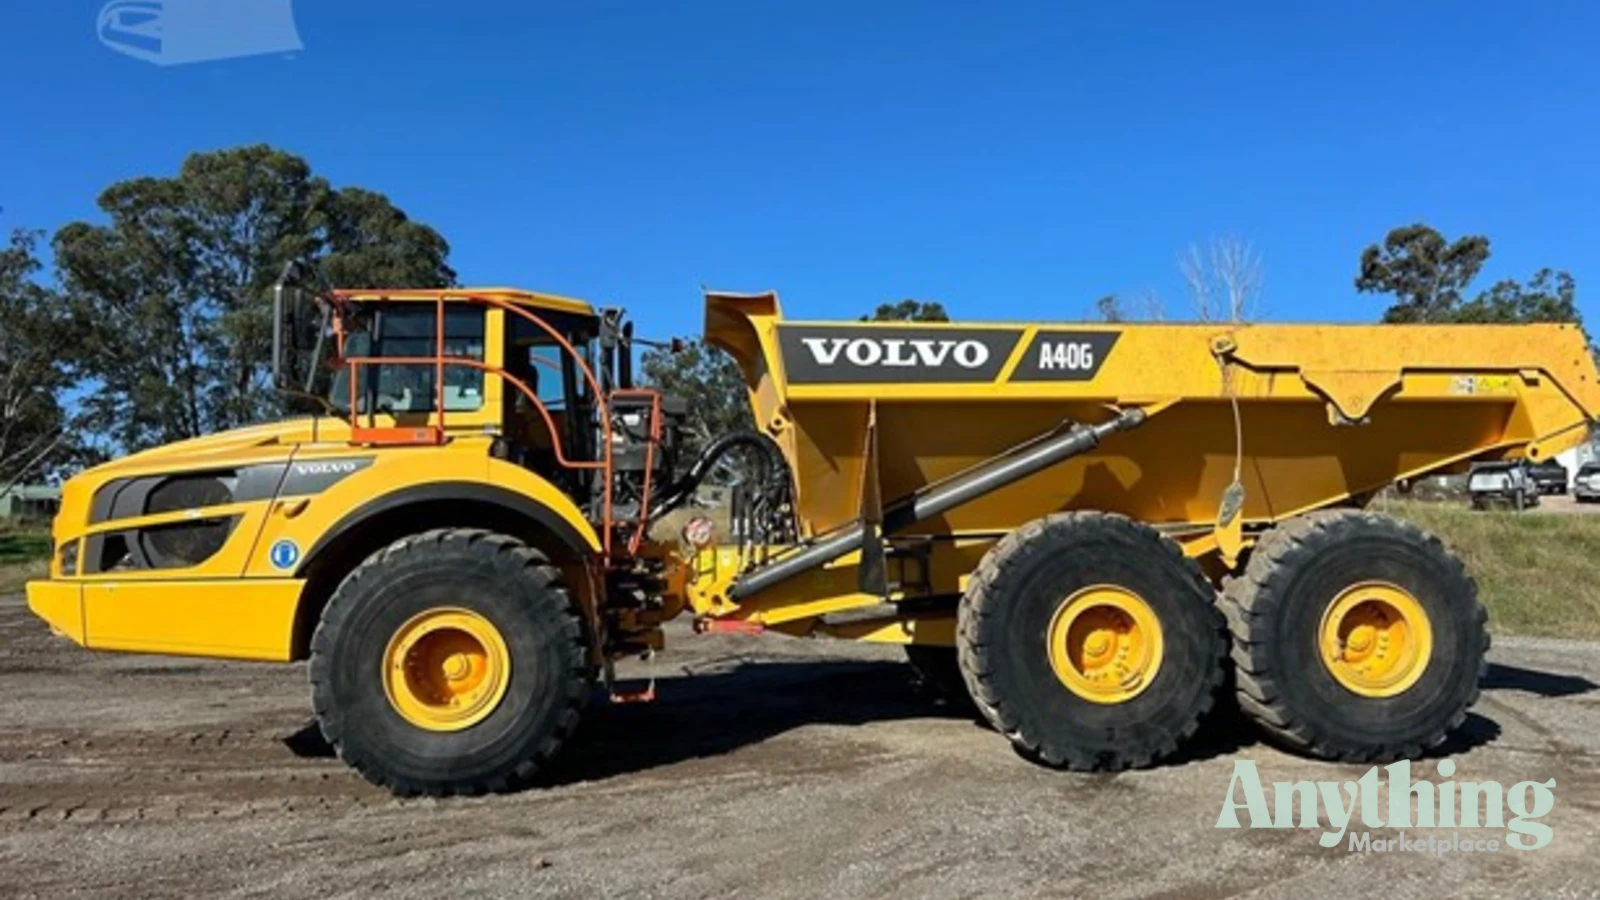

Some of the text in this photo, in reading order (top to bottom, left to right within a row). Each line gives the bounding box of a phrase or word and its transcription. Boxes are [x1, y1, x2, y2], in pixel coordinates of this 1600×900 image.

[802, 337, 989, 367] VOLVO
[1038, 343, 1093, 369] A40G
[297, 463, 355, 475] VOLVO
